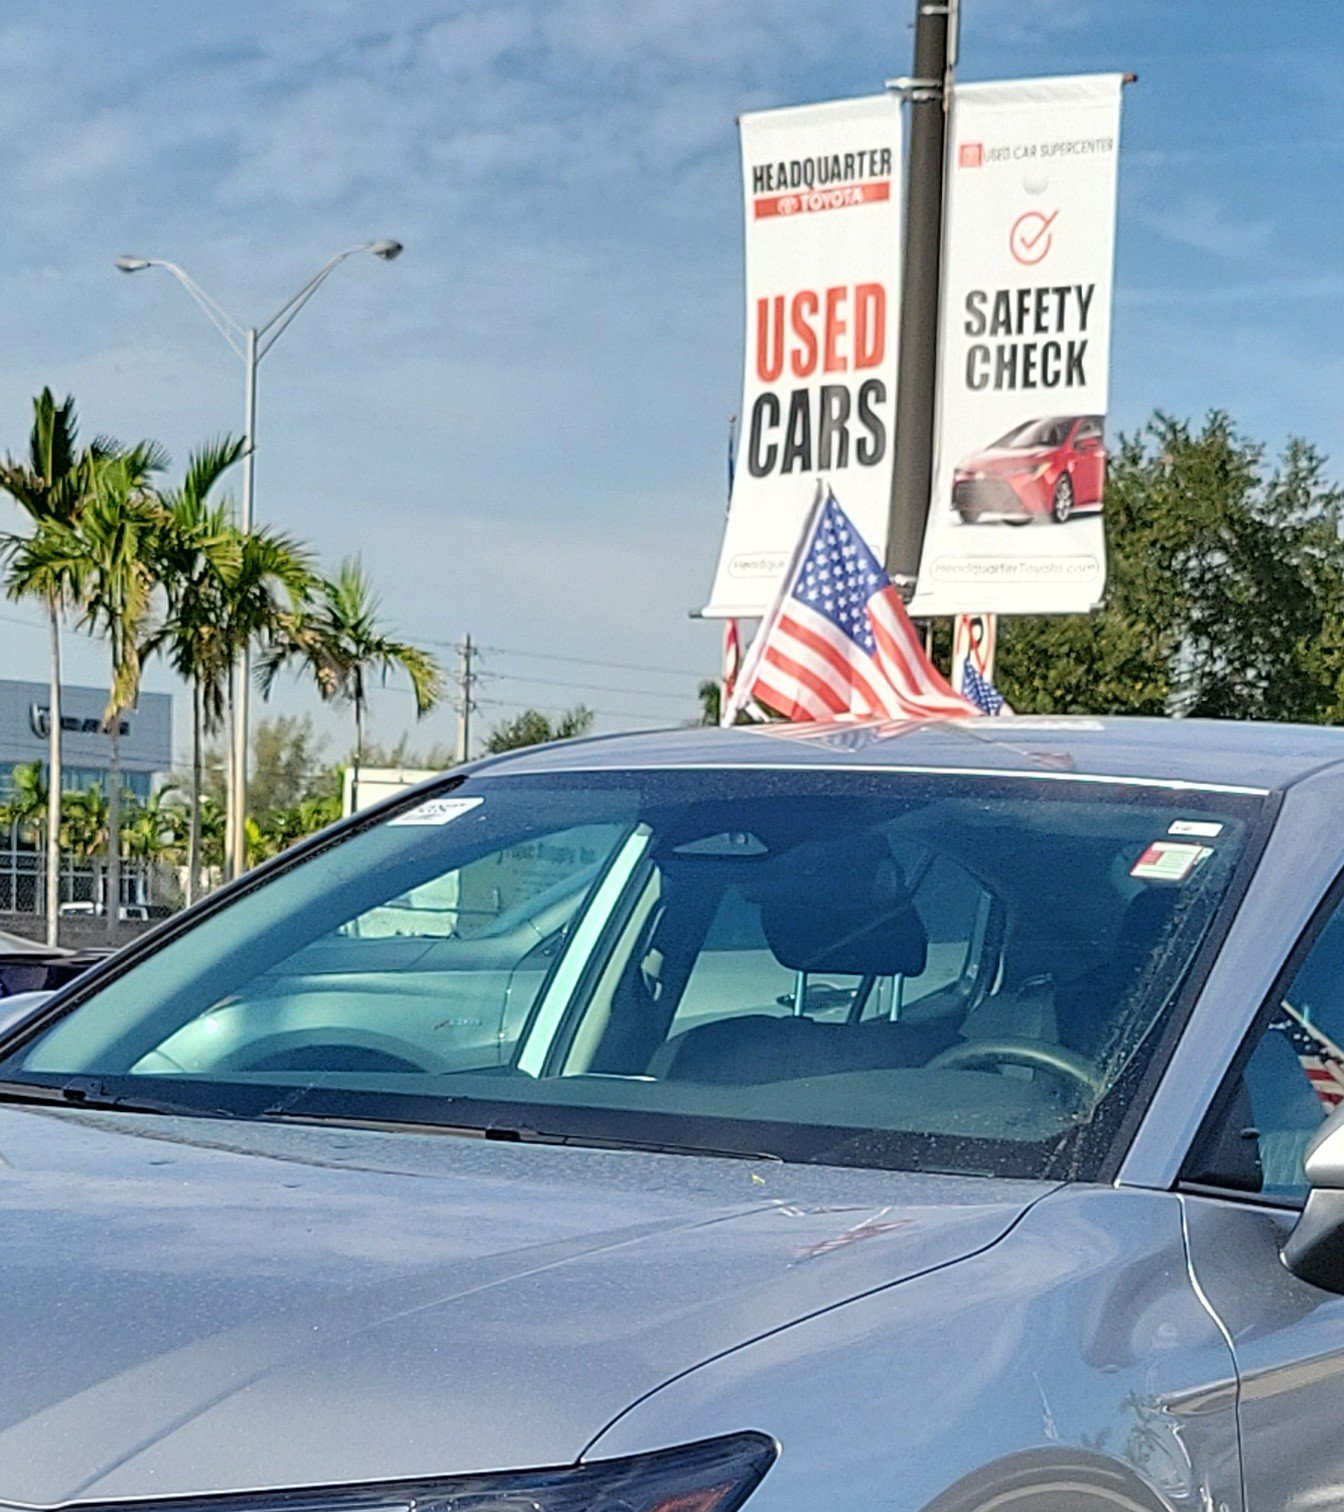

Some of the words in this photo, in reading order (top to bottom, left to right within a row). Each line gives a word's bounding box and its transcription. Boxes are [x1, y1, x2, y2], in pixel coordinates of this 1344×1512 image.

[752, 147, 893, 194] HEADQUARTER
[1013, 144, 1037, 161] CAR
[1040, 137, 1114, 158] SUPERCENTER
[800, 186, 864, 212] TOYOTA
[756, 282, 887, 383] USED
[963, 283, 1096, 338] SAFETY
[964, 338, 1089, 392] CHECK
[747, 377, 888, 479] CARS
